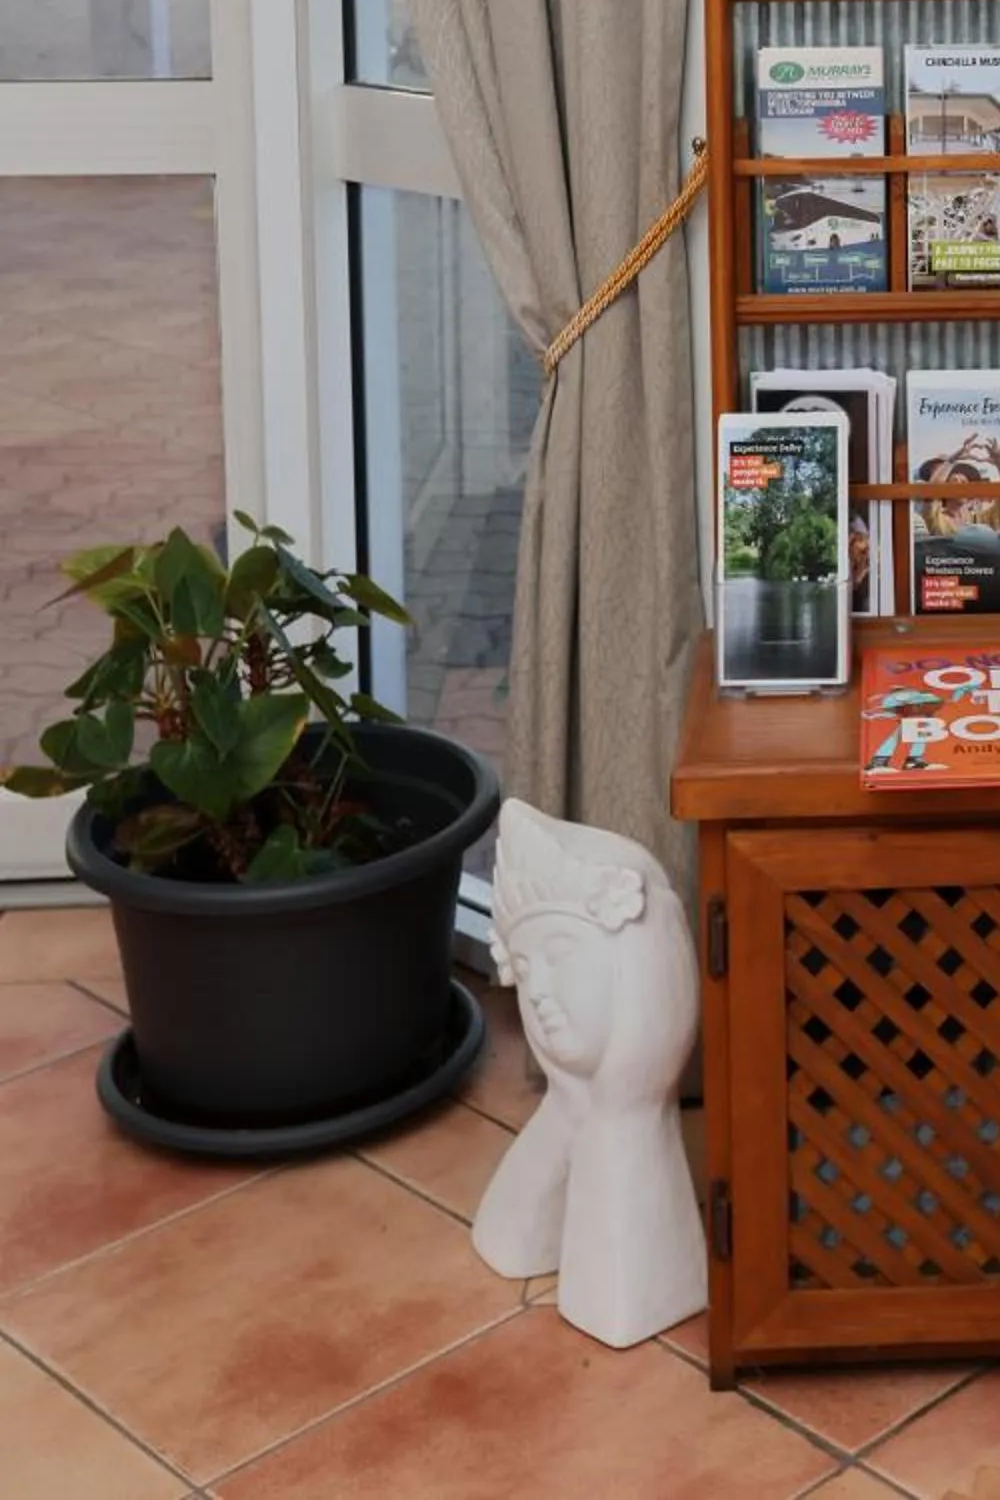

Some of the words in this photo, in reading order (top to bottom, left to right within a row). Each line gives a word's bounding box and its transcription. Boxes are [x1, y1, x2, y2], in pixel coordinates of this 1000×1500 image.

[925, 56, 977, 67] CHINCHILLA
[808, 63, 872, 77] MURRAYS
[919, 397, 979, 419] Experience
[733, 444, 777, 455] Experience
[780, 443, 802, 454] Dalby
[925, 556, 975, 567] Experience
